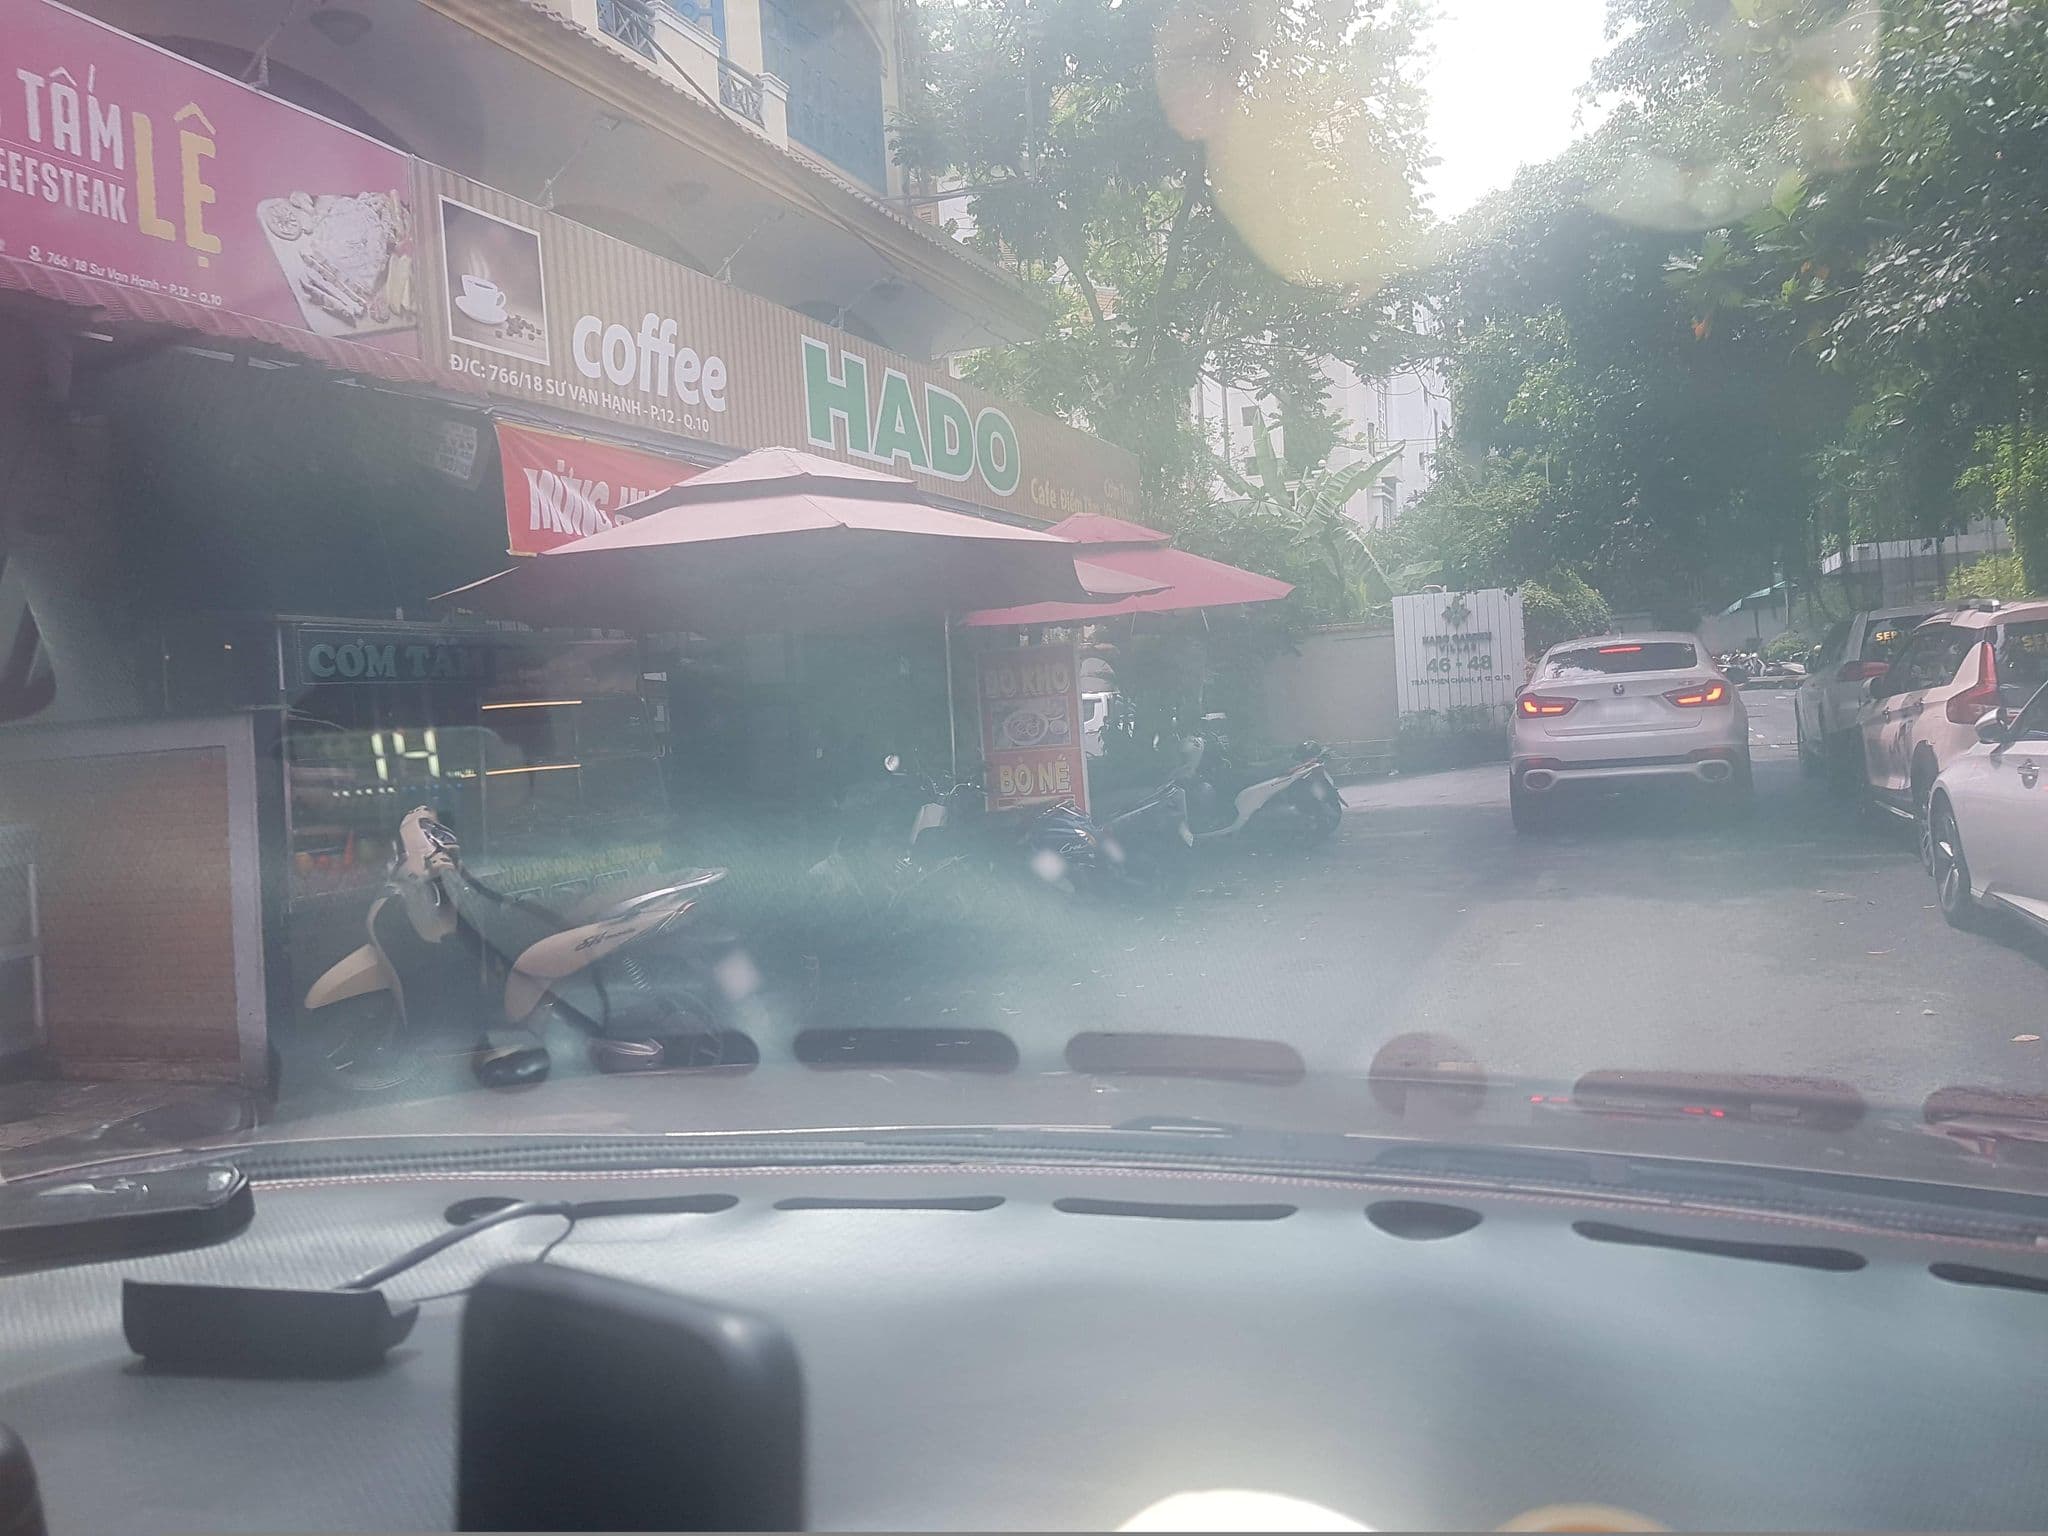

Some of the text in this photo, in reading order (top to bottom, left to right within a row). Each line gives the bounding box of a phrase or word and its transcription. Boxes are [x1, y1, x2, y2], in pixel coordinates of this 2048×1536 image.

[16, 63, 126, 171] TẤM
[131, 101, 223, 268] LỆ
[199, 292, 222, 306] Q.10
[489, 364, 543, 392] 766/18
[546, 379, 568, 397] SƯ
[569, 385, 599, 406] VẠN
[601, 393, 641, 415] HẠNH
[650, 405, 674, 423] P.12
[683, 413, 709, 433] Q.10
[800, 334, 1022, 497] HADO
[308, 636, 397, 678] CƠM
[1426, 657, 1451, 674] 46
[1467, 654, 1492, 672] 48
[371, 729, 440, 781] 14
